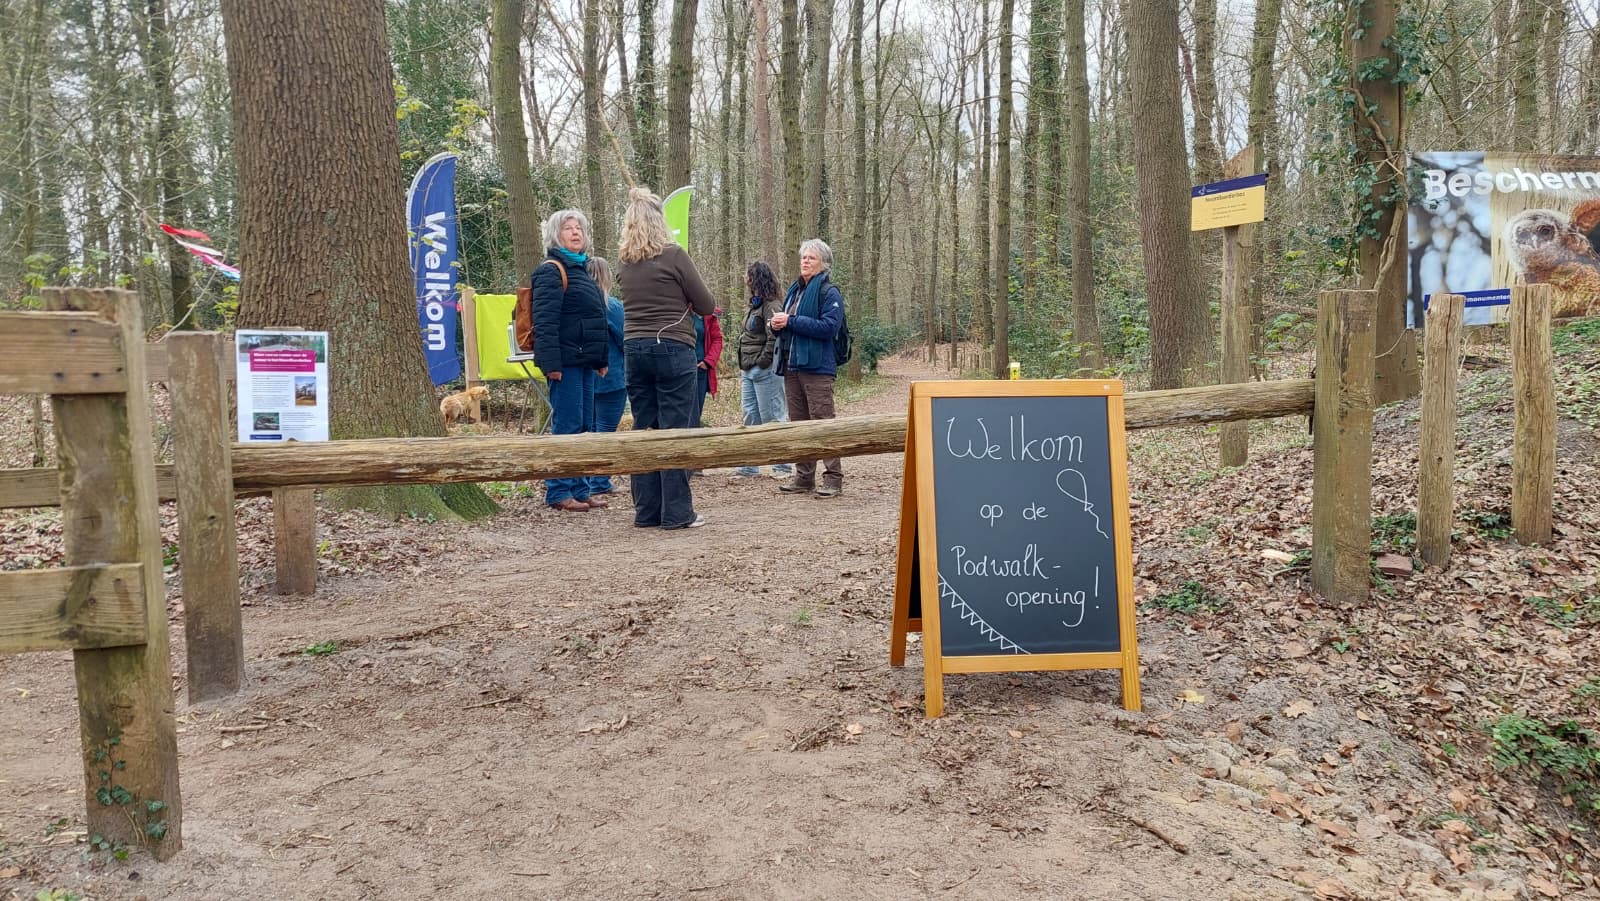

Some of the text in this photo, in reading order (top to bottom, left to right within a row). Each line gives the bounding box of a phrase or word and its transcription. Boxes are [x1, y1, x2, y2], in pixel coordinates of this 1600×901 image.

[424, 211, 451, 351] Welkom
[946, 414, 1083, 463] Welkom
[979, 501, 1049, 528] op de
[950, 543, 1062, 580] Podwalk-
